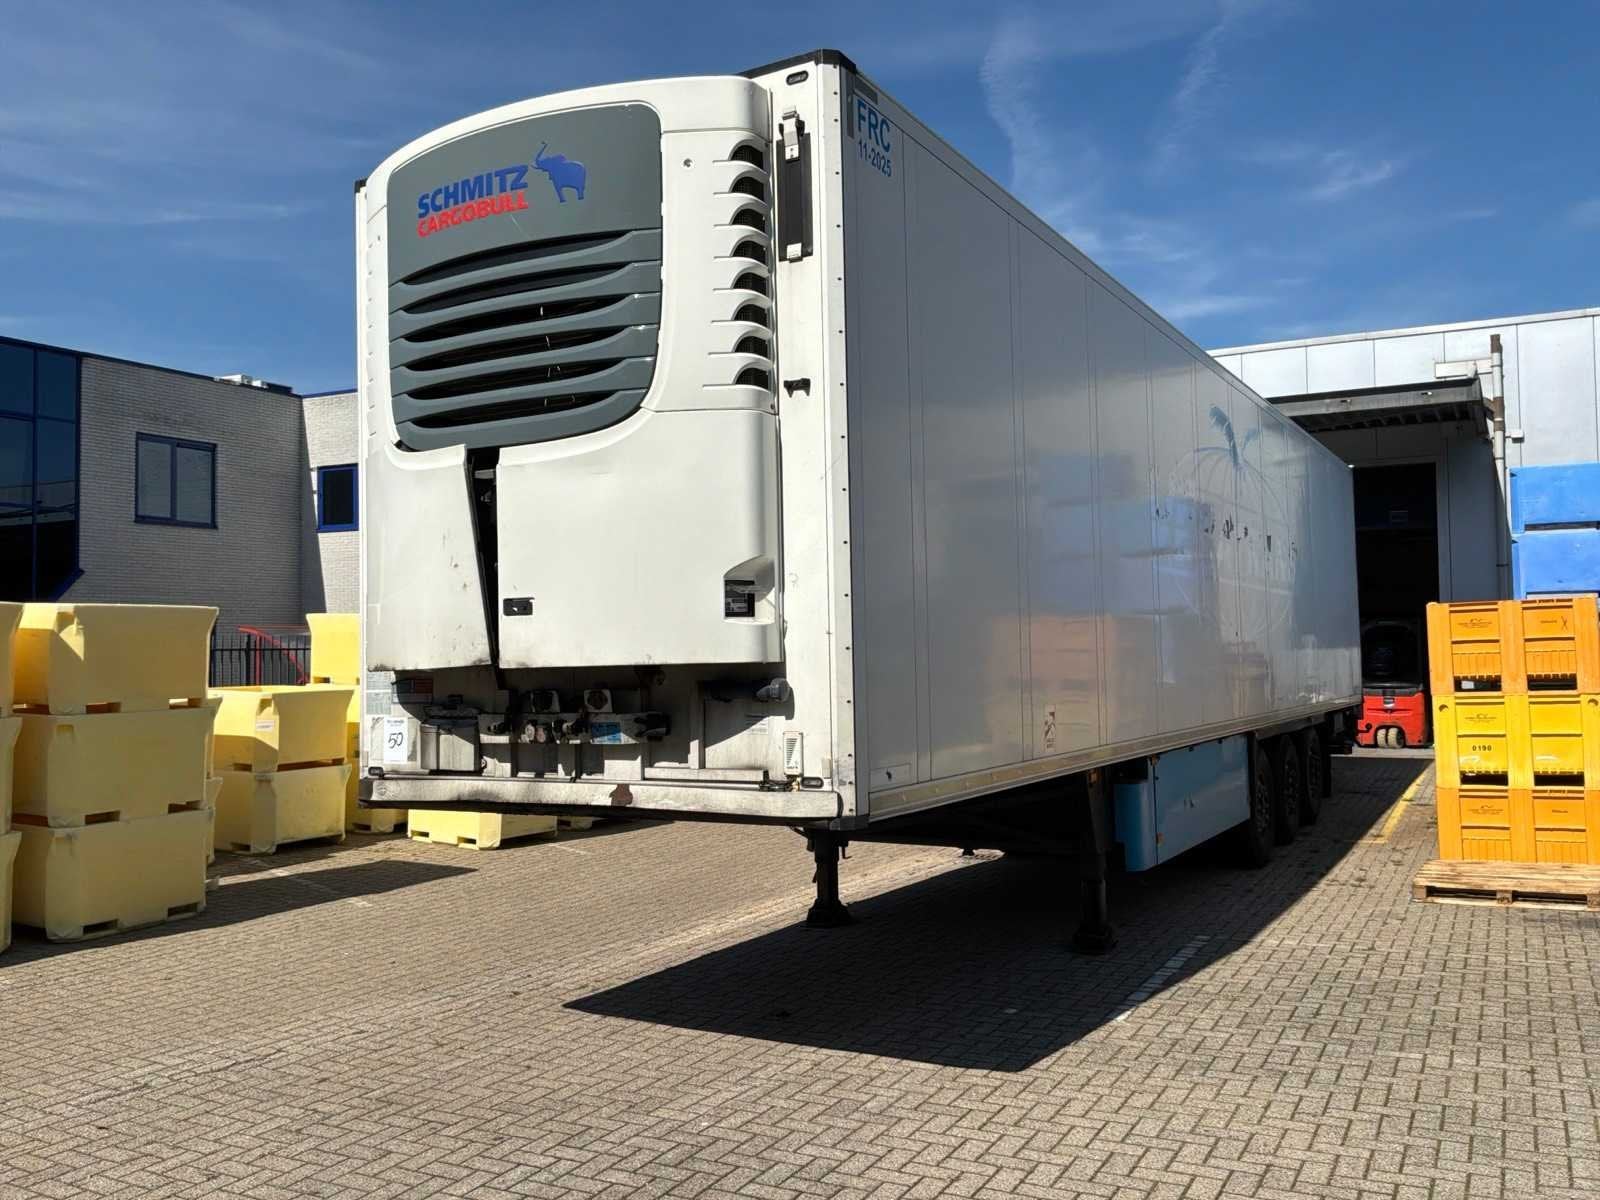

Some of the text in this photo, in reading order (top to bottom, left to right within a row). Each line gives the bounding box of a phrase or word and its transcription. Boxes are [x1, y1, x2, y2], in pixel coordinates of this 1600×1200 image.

[857, 99, 891, 153] FRC
[416, 191, 528, 239] CARGOBULL
[417, 164, 528, 218] SCHMITZ
